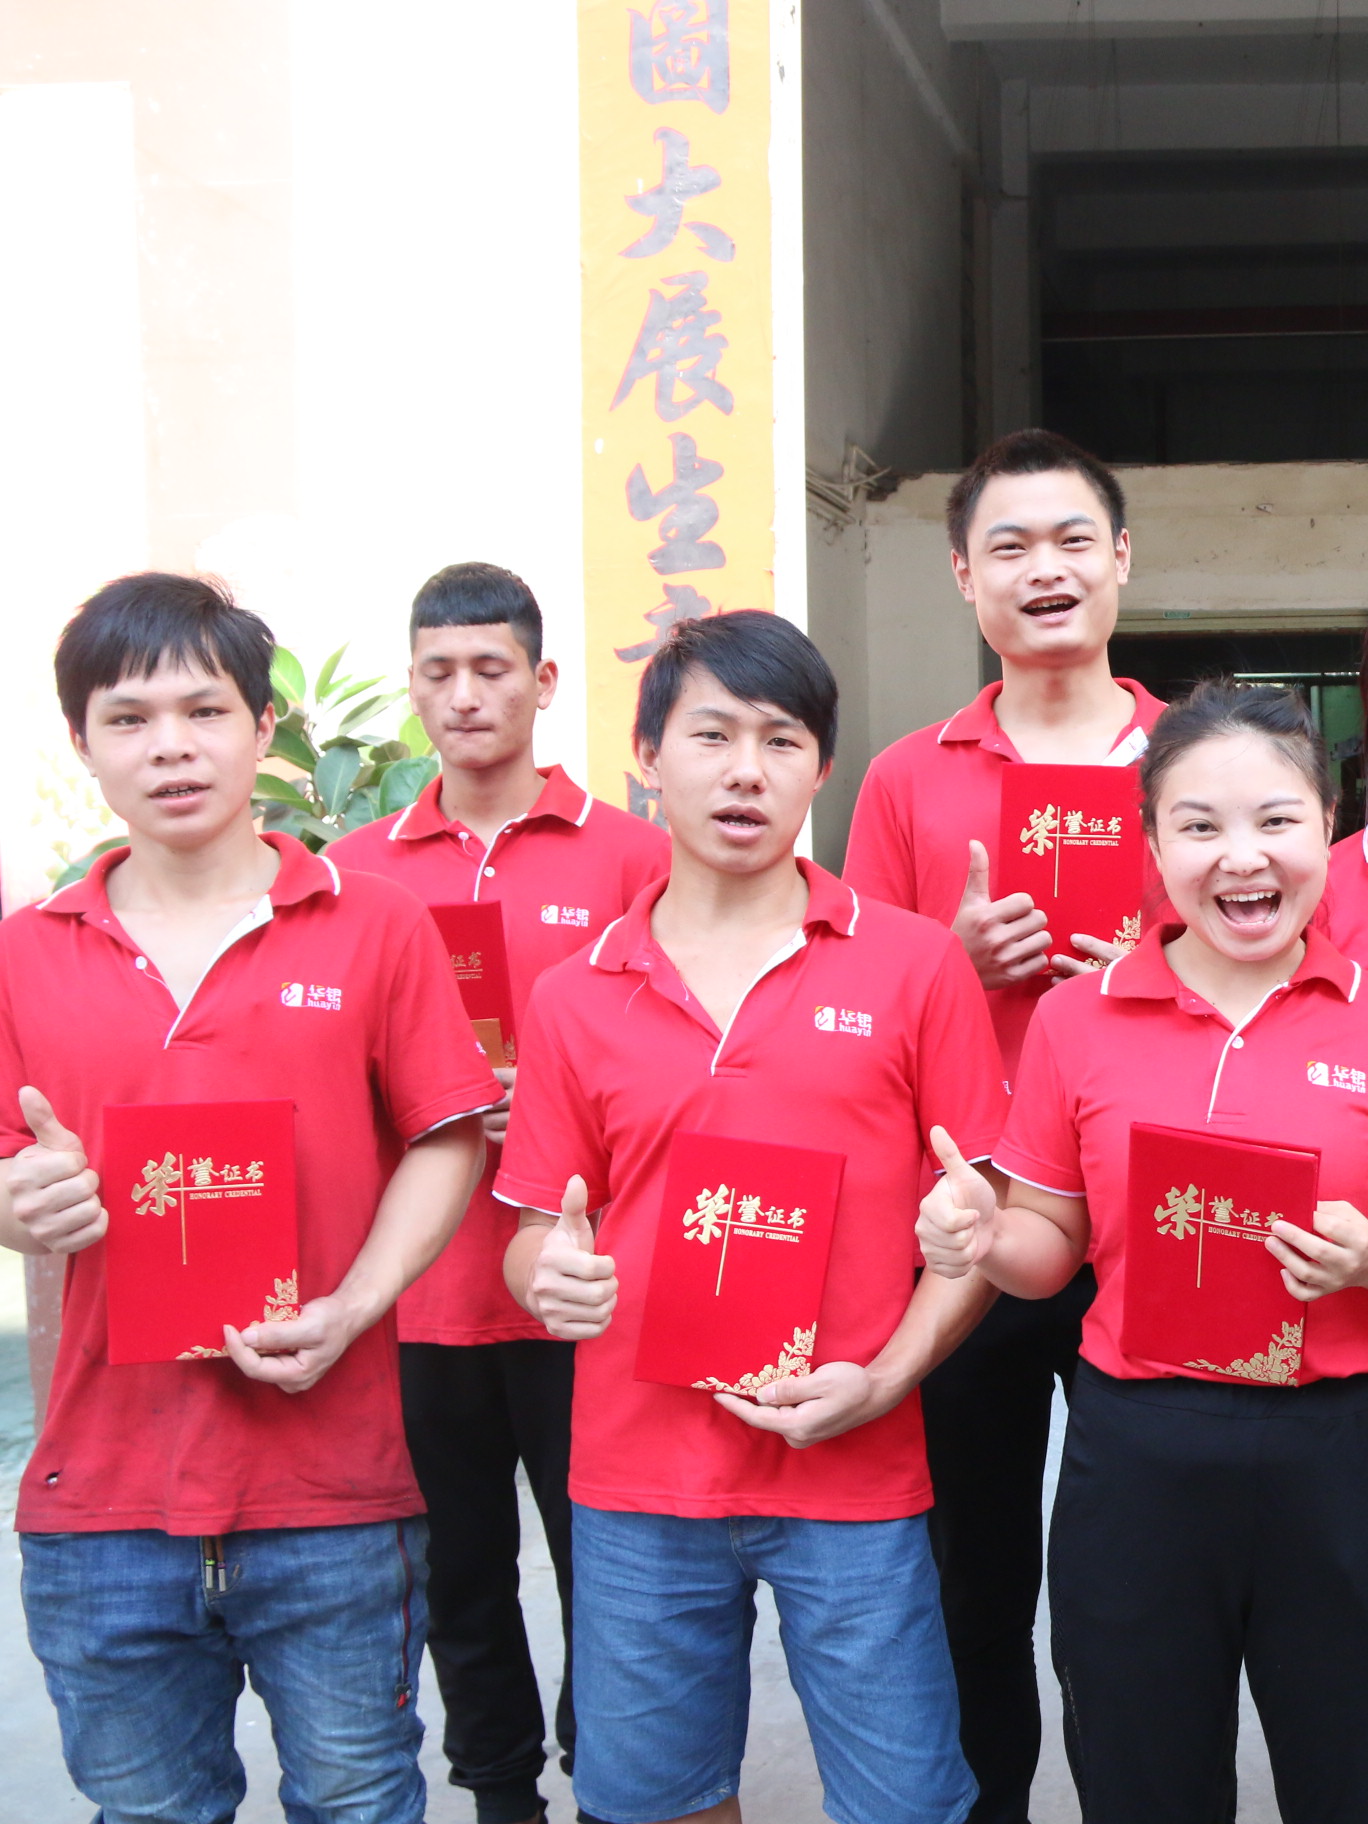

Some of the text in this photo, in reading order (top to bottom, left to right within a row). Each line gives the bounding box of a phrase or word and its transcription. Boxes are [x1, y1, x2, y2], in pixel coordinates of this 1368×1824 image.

[609, 0, 736, 818] 圖大展生
[307, 998, 341, 1011] huayin
[838, 1022, 872, 1037] huayin
[1333, 1078, 1366, 1093] huayin
[189, 1189, 262, 1200] HONORARY CREDENTIAL
[733, 1227, 800, 1243] HONORARY CREDENTIAL
[1208, 1226, 1267, 1242] HONORARY CREDEN
